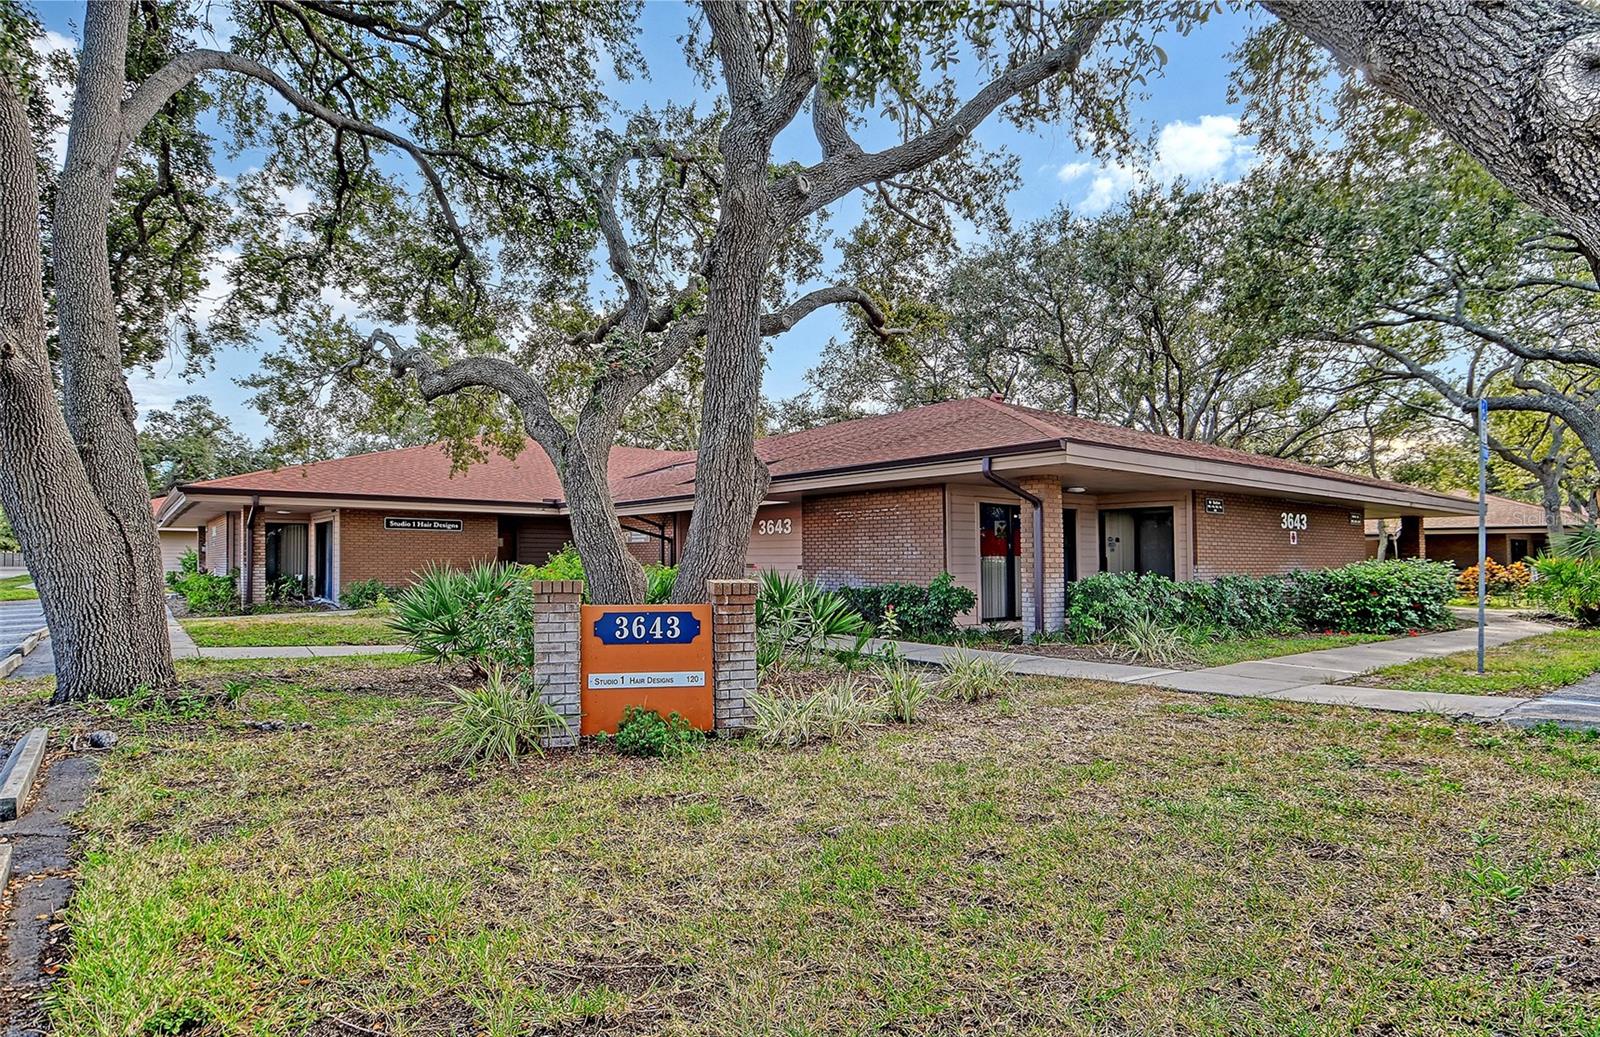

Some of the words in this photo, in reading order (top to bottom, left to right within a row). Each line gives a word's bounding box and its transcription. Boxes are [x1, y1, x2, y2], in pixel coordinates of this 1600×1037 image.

[433, 522, 459, 530] Designs
[758, 518, 792, 535] 3643
[1281, 512, 1307, 530] 3643
[615, 616, 681, 639] 3643
[620, 676, 625, 685] 1
[686, 675, 700, 683] 120
